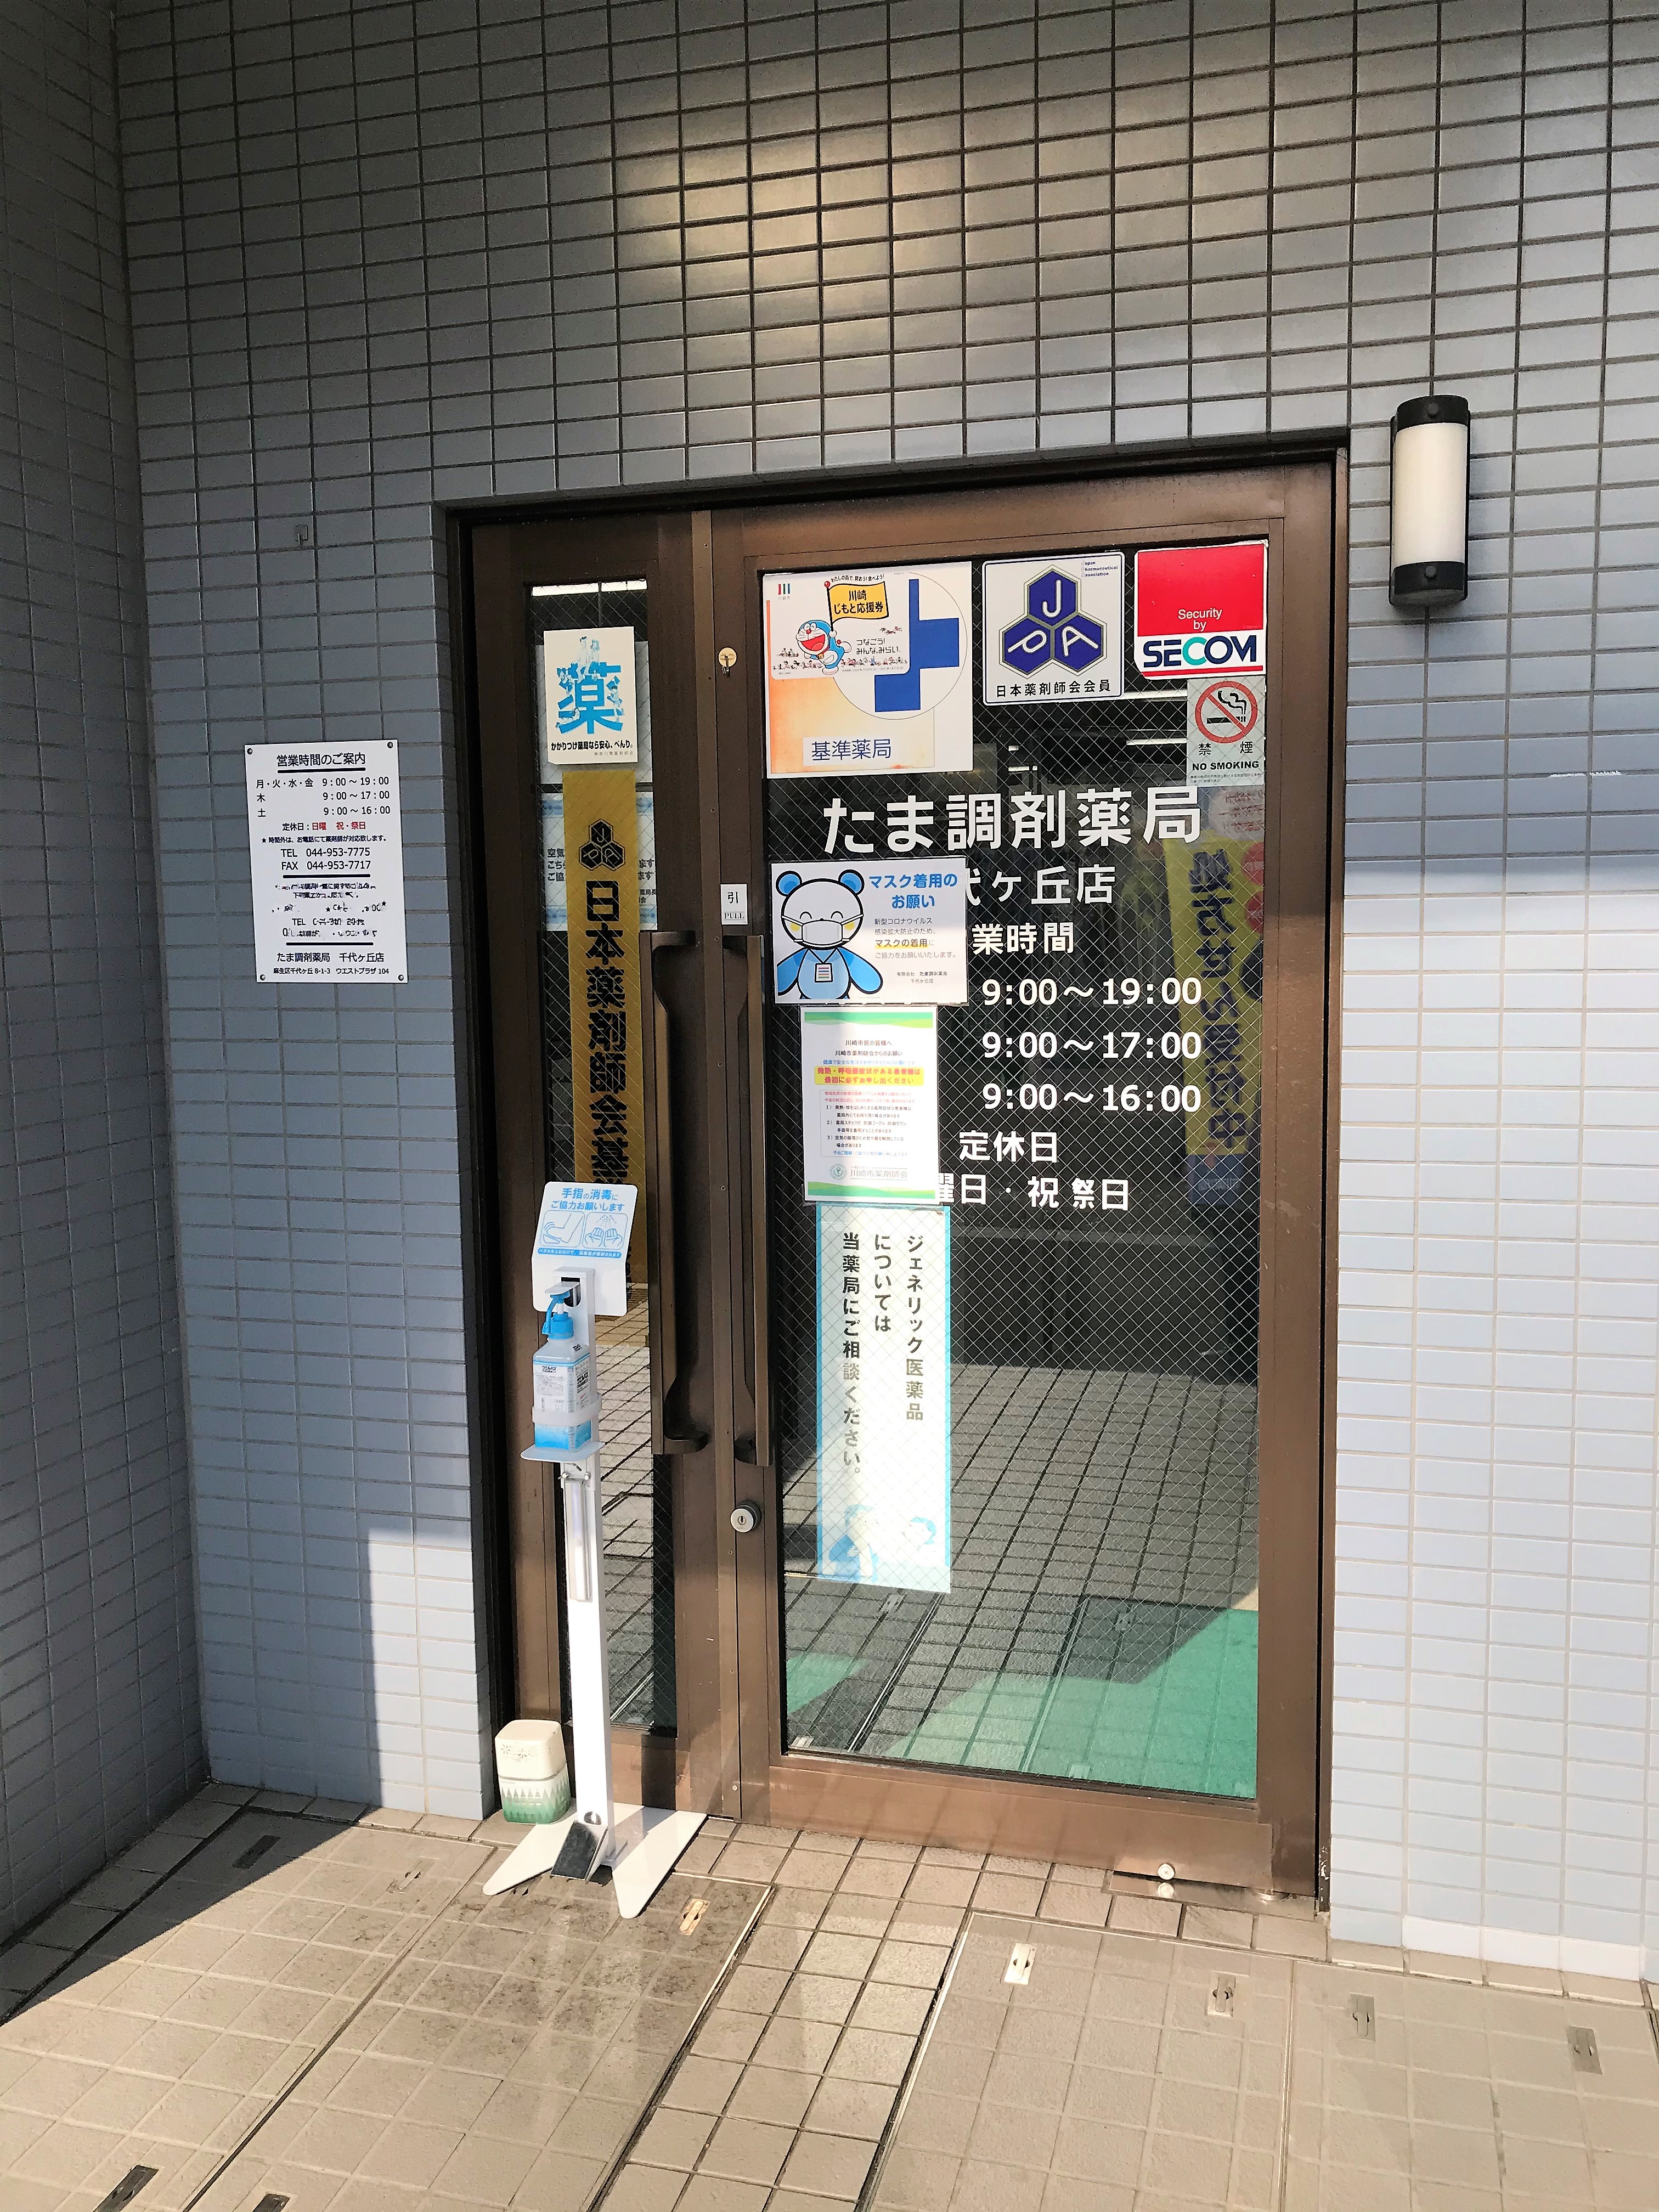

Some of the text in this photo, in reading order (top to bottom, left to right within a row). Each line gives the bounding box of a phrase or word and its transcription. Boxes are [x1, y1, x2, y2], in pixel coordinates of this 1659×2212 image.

[849, 590, 867, 601] 川崎
[834, 602, 883, 614] じもと応援券
[1177, 608, 1223, 620] Security
[1193, 620, 1207, 631] by
[1143, 635, 1257, 668] SECOM
[996, 679, 1111, 698] 日本薬剤師会会員
[811, 739, 891, 761] 基準薬局
[276, 752, 365, 767] 営業時間のご案内
[1192, 761, 1260, 771] NO SMOKING
[257, 794, 266, 803] 木
[257, 809, 266, 818] 土
[823, 786, 1201, 854] たま調剤薬局
[280, 848, 370, 857] TEL 044-953-7775
[281, 860, 371, 870] FAX 044-953-7717
[869, 873, 957, 889] マスク着用の
[727, 891, 738, 904] 引
[891, 894, 935, 909] お願い
[875, 938, 935, 947] マスクの着用に
[972, 922, 1074, 955] 業時間
[276, 952, 330, 962] たま調剤薬局
[585, 880, 629, 1184] 日本薬剤師会基
[958, 1130, 1057, 1163] 定休日
[562, 1188, 618, 1201] 手指の消毒に
[551, 1200, 625, 1212] ご協力お願いします
[874, 1233, 892, 1333] については
[905, 1234, 924, 1421] ジェネリック医薬品
[842, 1232, 861, 1474] 当薬局にご相談ください。
